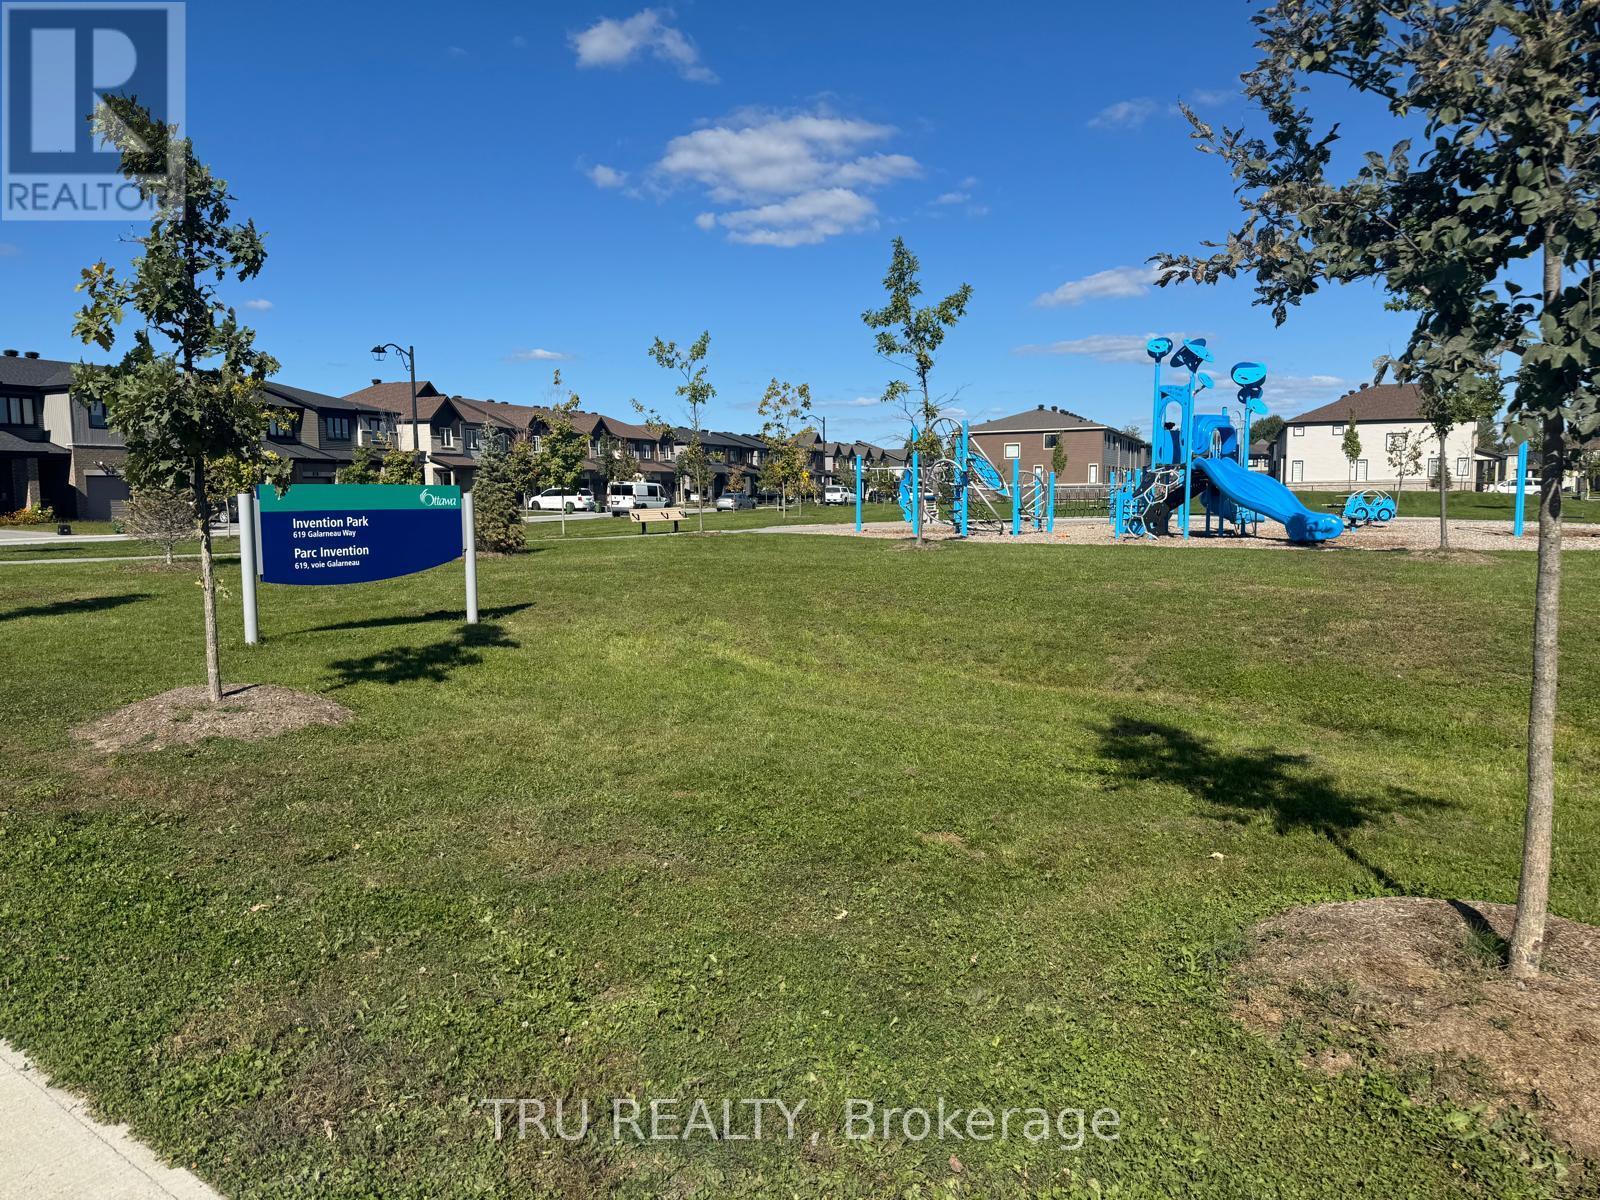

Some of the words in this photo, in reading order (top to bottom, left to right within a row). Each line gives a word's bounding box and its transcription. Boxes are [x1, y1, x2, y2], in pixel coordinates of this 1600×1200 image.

[420, 489, 457, 507] Ottawa
[293, 517, 343, 529] Invention
[346, 516, 369, 527] Park
[293, 531, 306, 539] 619
[307, 530, 341, 538] Galarneau
[342, 529, 356, 538] Way
[294, 548, 317, 559] Parc
[320, 545, 369, 558] Invention
[294, 562, 310, 570] 619,
[311, 560, 325, 569] voie
[326, 559, 360, 568] Galarneau
